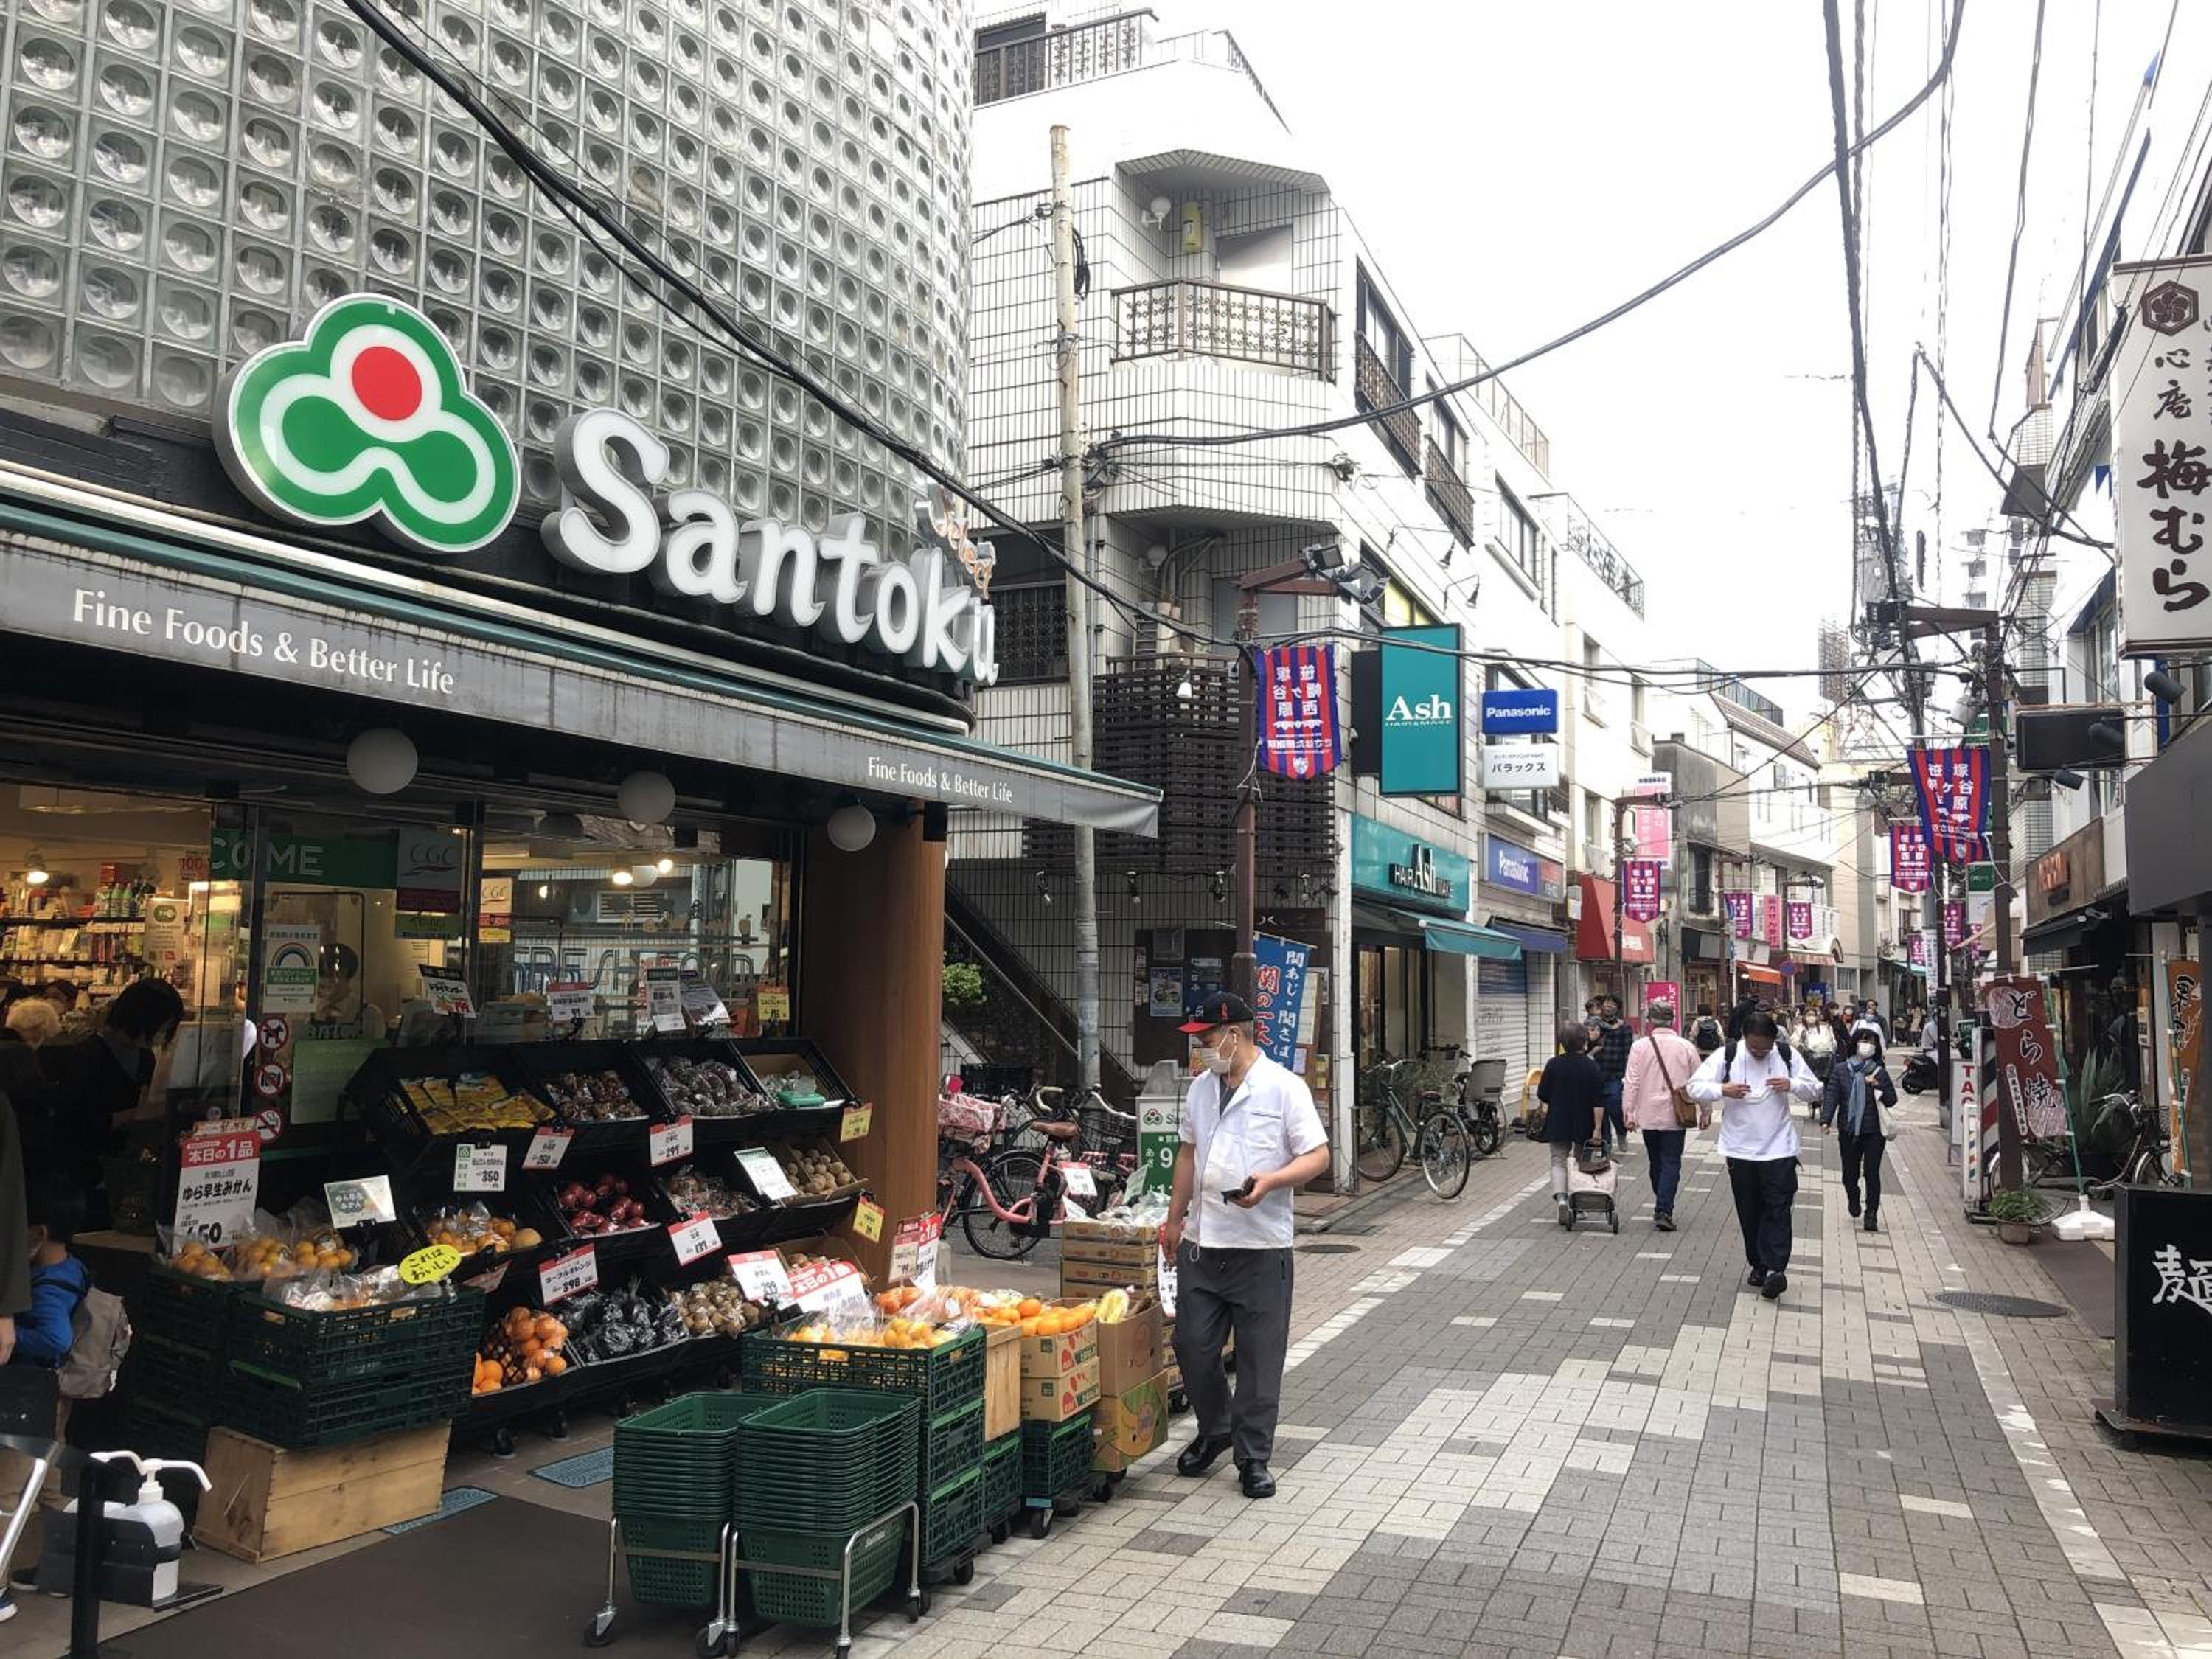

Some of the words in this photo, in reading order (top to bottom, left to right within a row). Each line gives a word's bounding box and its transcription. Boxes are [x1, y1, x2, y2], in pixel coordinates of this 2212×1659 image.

[2154, 348, 2192, 420] 心庵
[2138, 439, 2212, 611] 梅むら
[544, 407, 1000, 686] Santoku
[73, 588, 153, 636] Fine
[164, 608, 264, 656] Foods
[274, 631, 299, 663] &
[309, 637, 397, 683] Better
[406, 656, 455, 695] Life
[1385, 694, 1452, 721] Ash
[1486, 704, 1551, 719] Panasonic
[868, 757, 897, 781] Fine
[900, 763, 937, 788] Foods
[940, 773, 951, 790] &
[954, 774, 990, 799] Better
[993, 782, 1013, 803] Life
[2008, 990, 2056, 1110] どら焼
[188, 1139, 254, 1164] 本日の1品
[1159, 1147, 1174, 1169] 9
[481, 1170, 500, 1182] 350
[182, 1178, 254, 1203] ゆら早生みかん
[408, 1248, 445, 1267] これは
